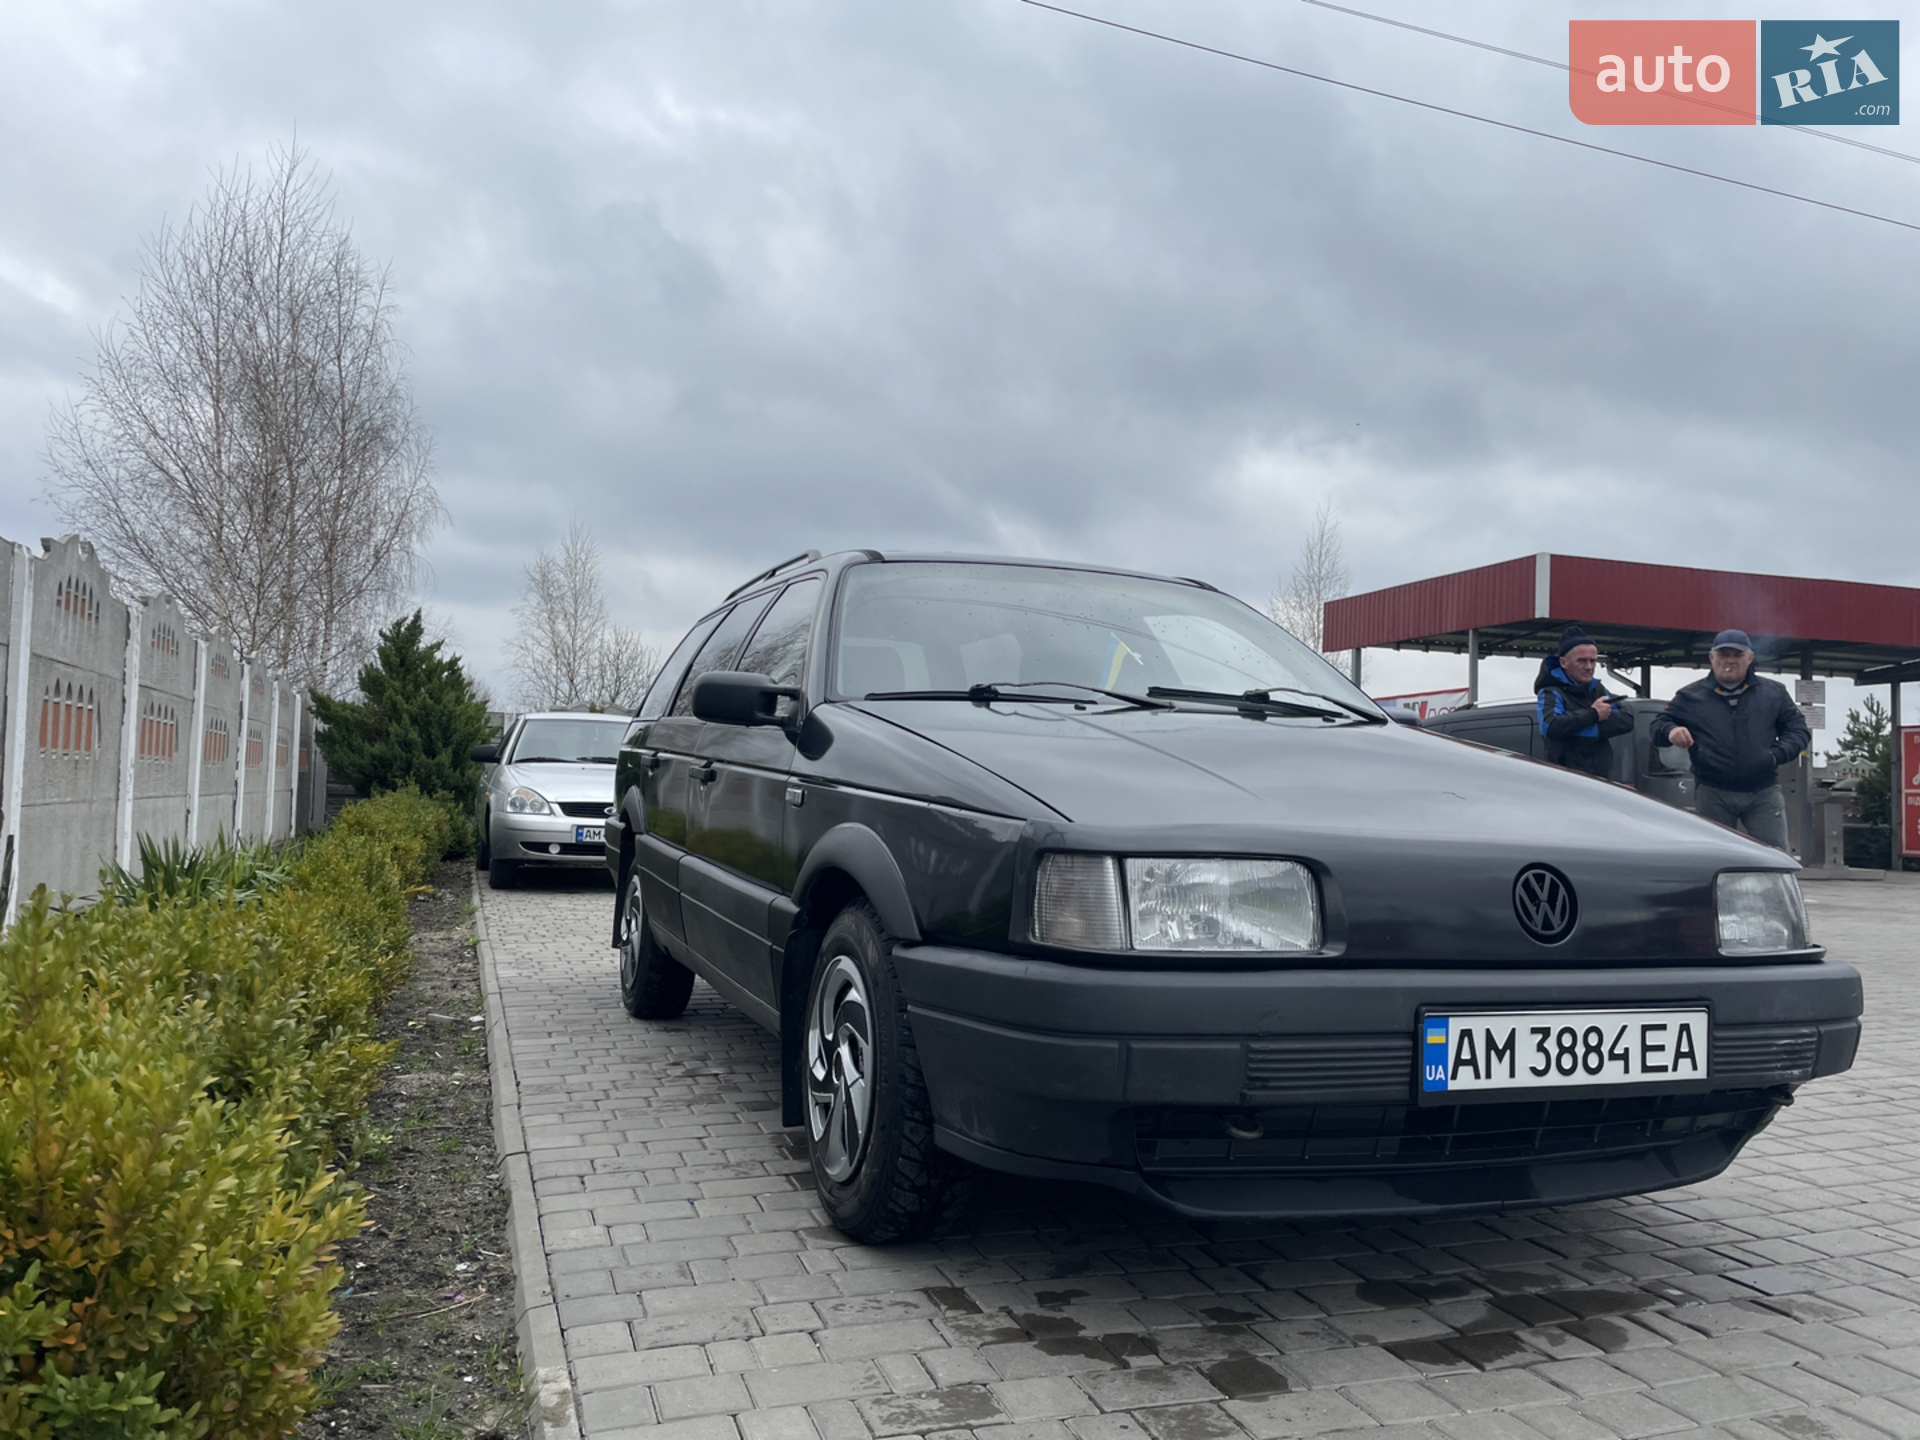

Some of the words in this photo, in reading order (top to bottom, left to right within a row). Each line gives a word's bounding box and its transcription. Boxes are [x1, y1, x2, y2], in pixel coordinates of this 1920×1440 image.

[584, 829, 602, 841] AM
[1450, 1027, 1517, 1081] AM
[1529, 1024, 1631, 1078] 3884
[1640, 1022, 1699, 1074] EA
[1426, 1064, 1446, 1081] UA
